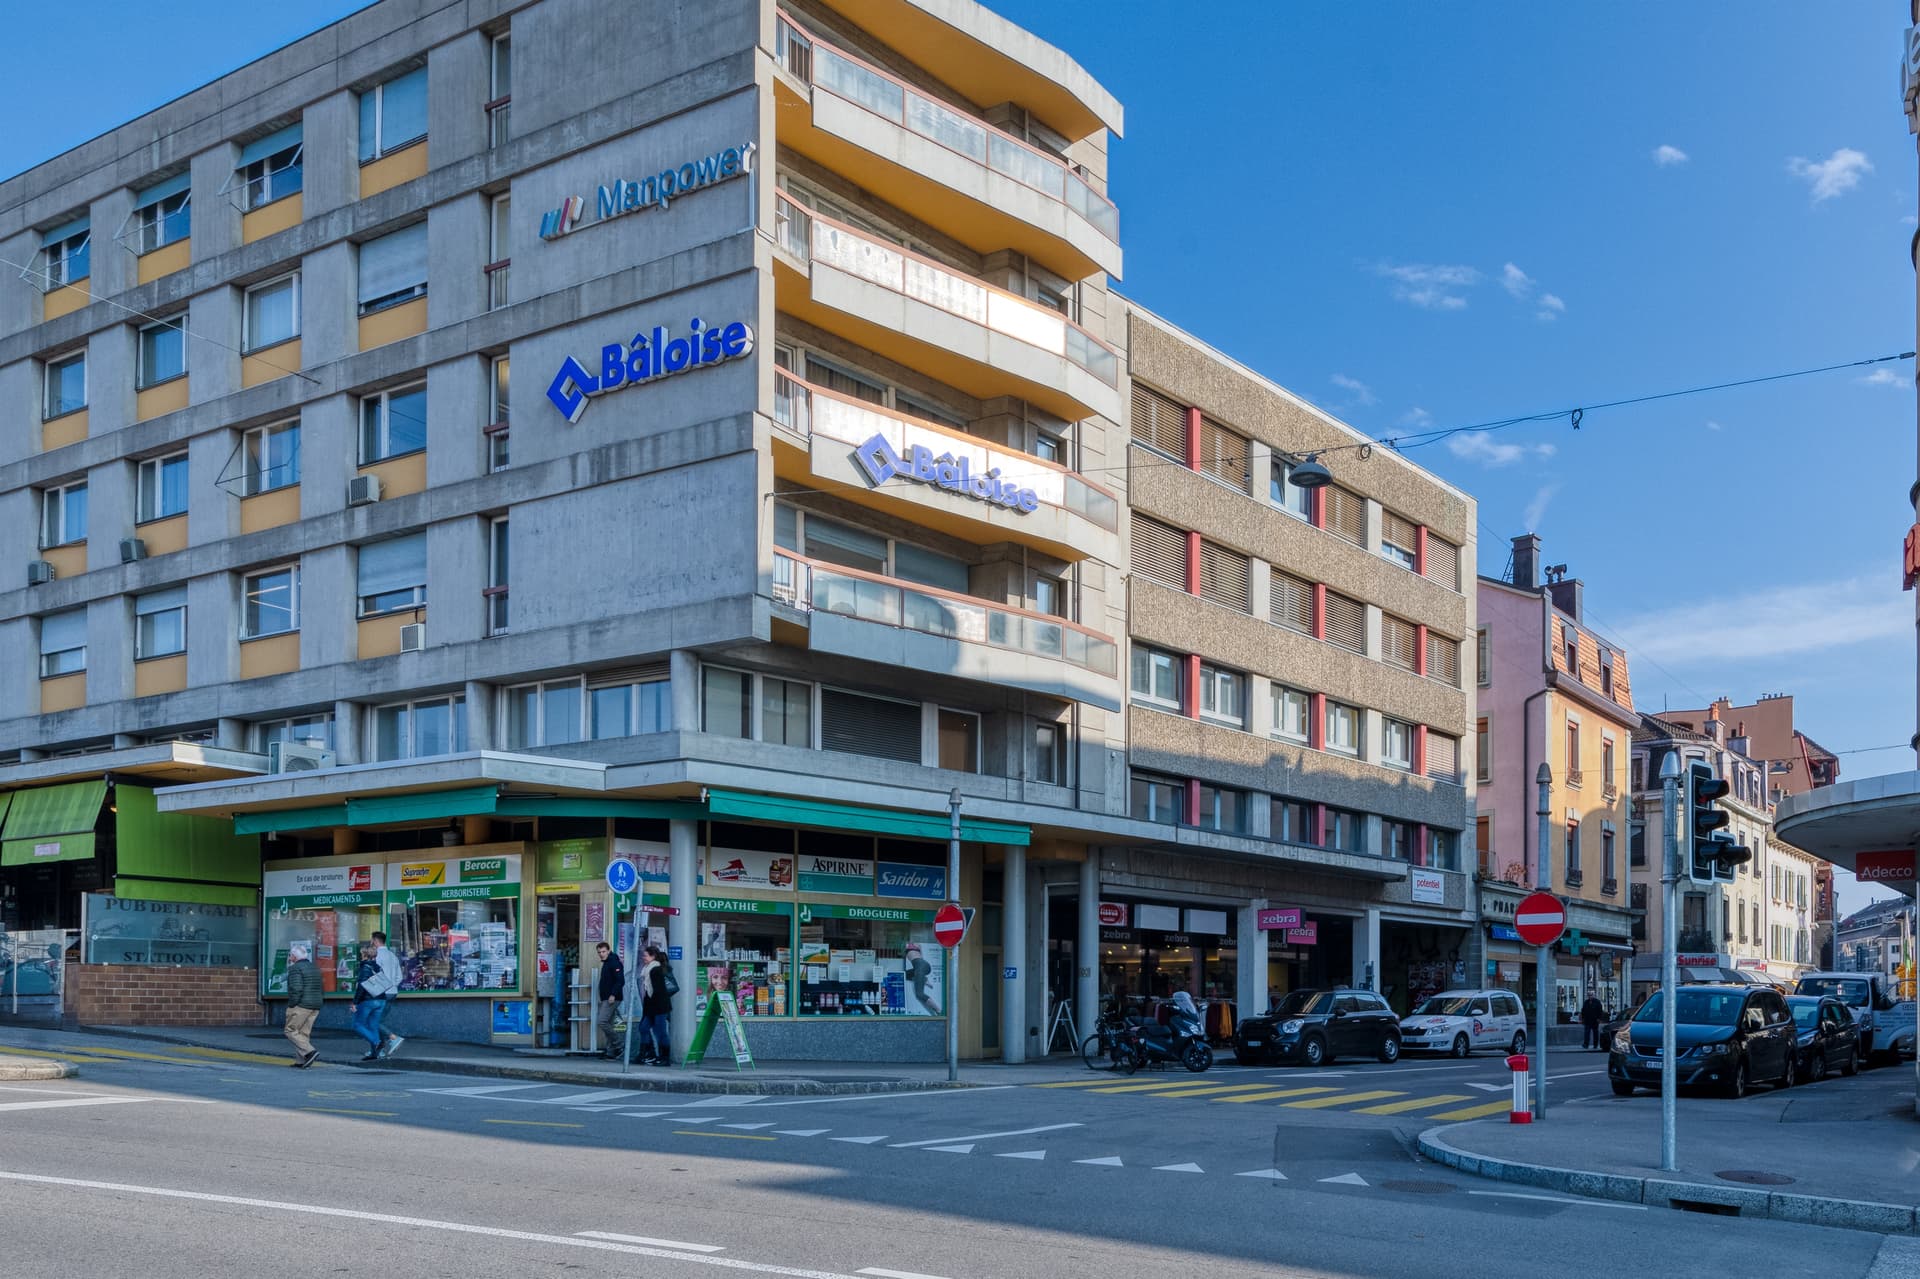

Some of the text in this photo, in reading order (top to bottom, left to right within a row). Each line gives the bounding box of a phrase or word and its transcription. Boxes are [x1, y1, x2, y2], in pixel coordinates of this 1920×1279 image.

[597, 141, 755, 220] Manpower
[601, 317, 754, 390] Bâloise
[911, 443, 1040, 514] Bâloise
[464, 860, 501, 872] Berocca
[812, 858, 865, 876] ASPIRINE
[1863, 865, 1912, 878] Adecco
[879, 871, 929, 888] Saridon
[441, 887, 491, 898] HERBORISTERIE
[105, 897, 146, 912] PUB
[1493, 900, 1517, 914] PHAR
[849, 908, 910, 920] DROGUERIE
[1262, 913, 1297, 924] zebra
[1103, 929, 1131, 940] zebra
[1288, 926, 1315, 937] zebra
[1164, 934, 1189, 943] zebra
[1219, 937, 1238, 946] zebr
[123, 951, 232, 965] STATION PUB
[1677, 954, 1717, 966] Sunrise
